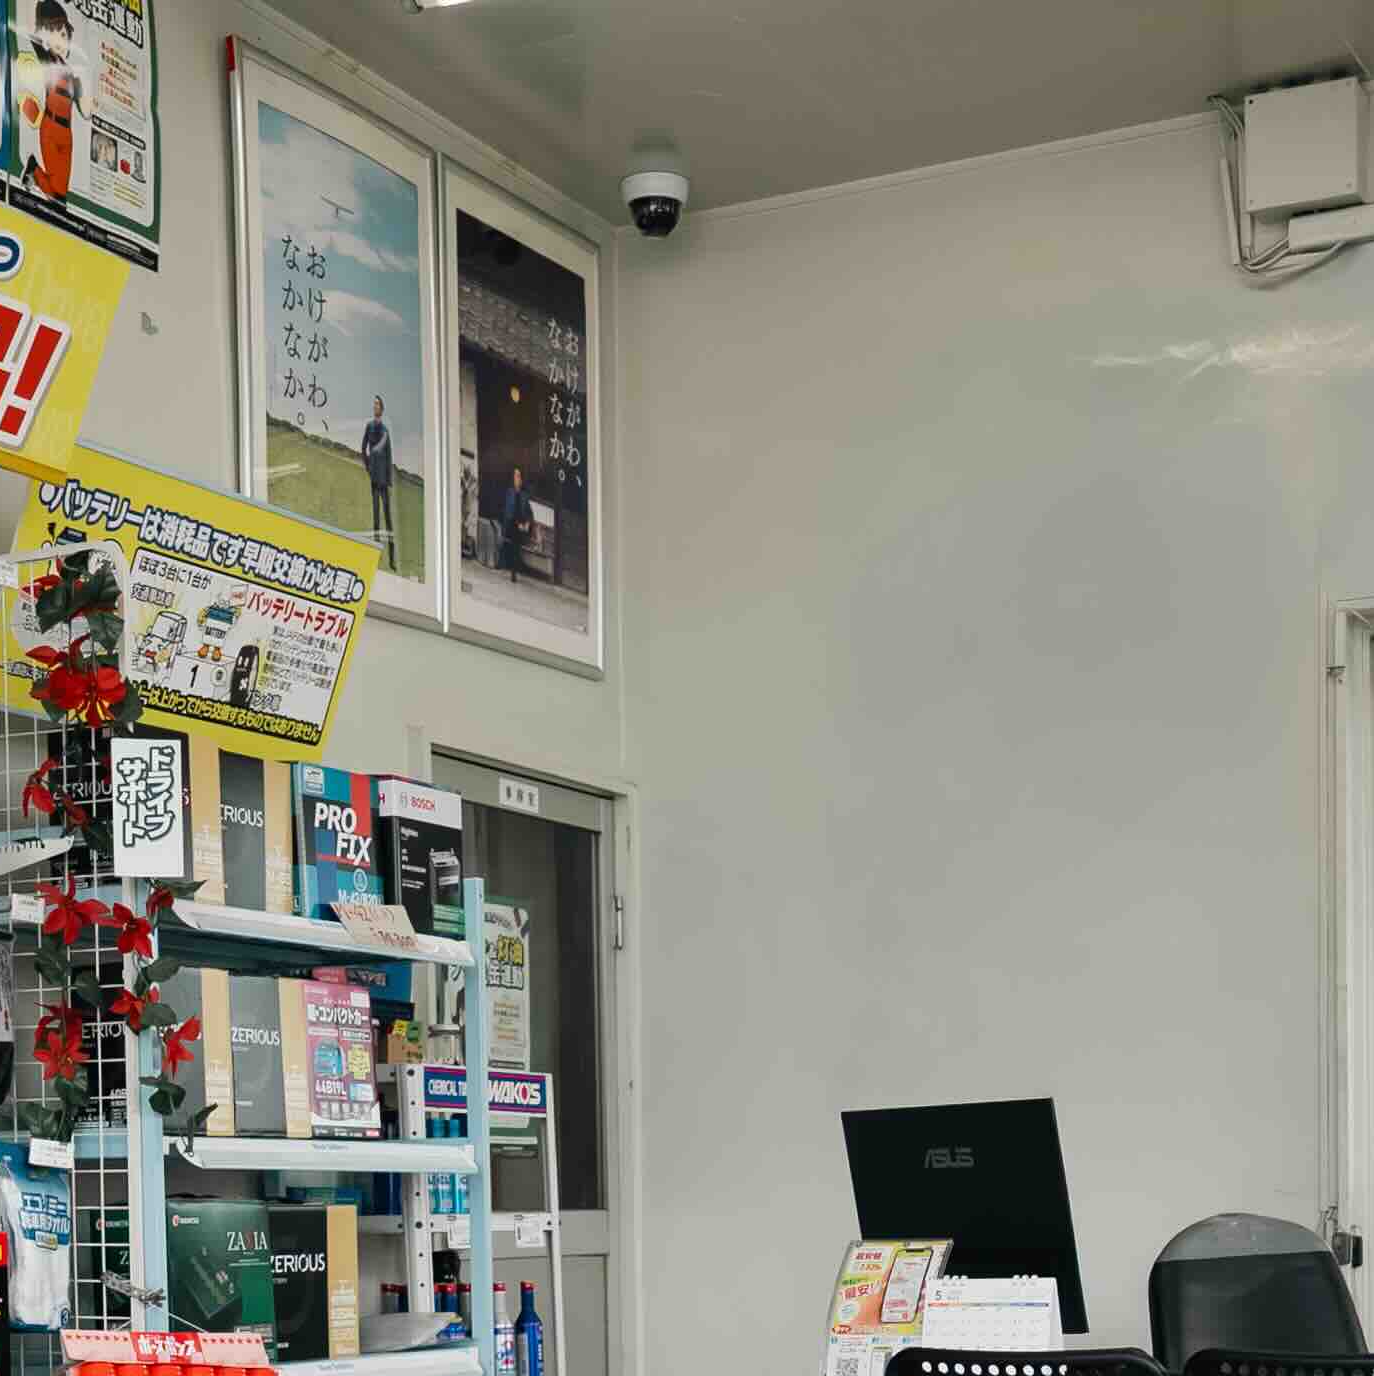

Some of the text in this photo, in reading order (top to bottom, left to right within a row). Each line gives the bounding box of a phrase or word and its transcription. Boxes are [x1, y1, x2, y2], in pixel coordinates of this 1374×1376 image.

[280, 233, 308, 428] なかなか。
[305, 246, 329, 432] おけがわ、
[546, 317, 568, 483] なかなか。
[564, 331, 583, 487] おけがわ、
[247, 591, 349, 639] バッテリートラブル
[187, 664, 200, 689] 1
[116, 757, 147, 848] サポート
[145, 745, 176, 840] ドライブ
[313, 802, 358, 834] PRO
[336, 834, 373, 866] FIX
[231, 1027, 281, 1046] ZERIOUS
[924, 1147, 975, 1169] ASUS
